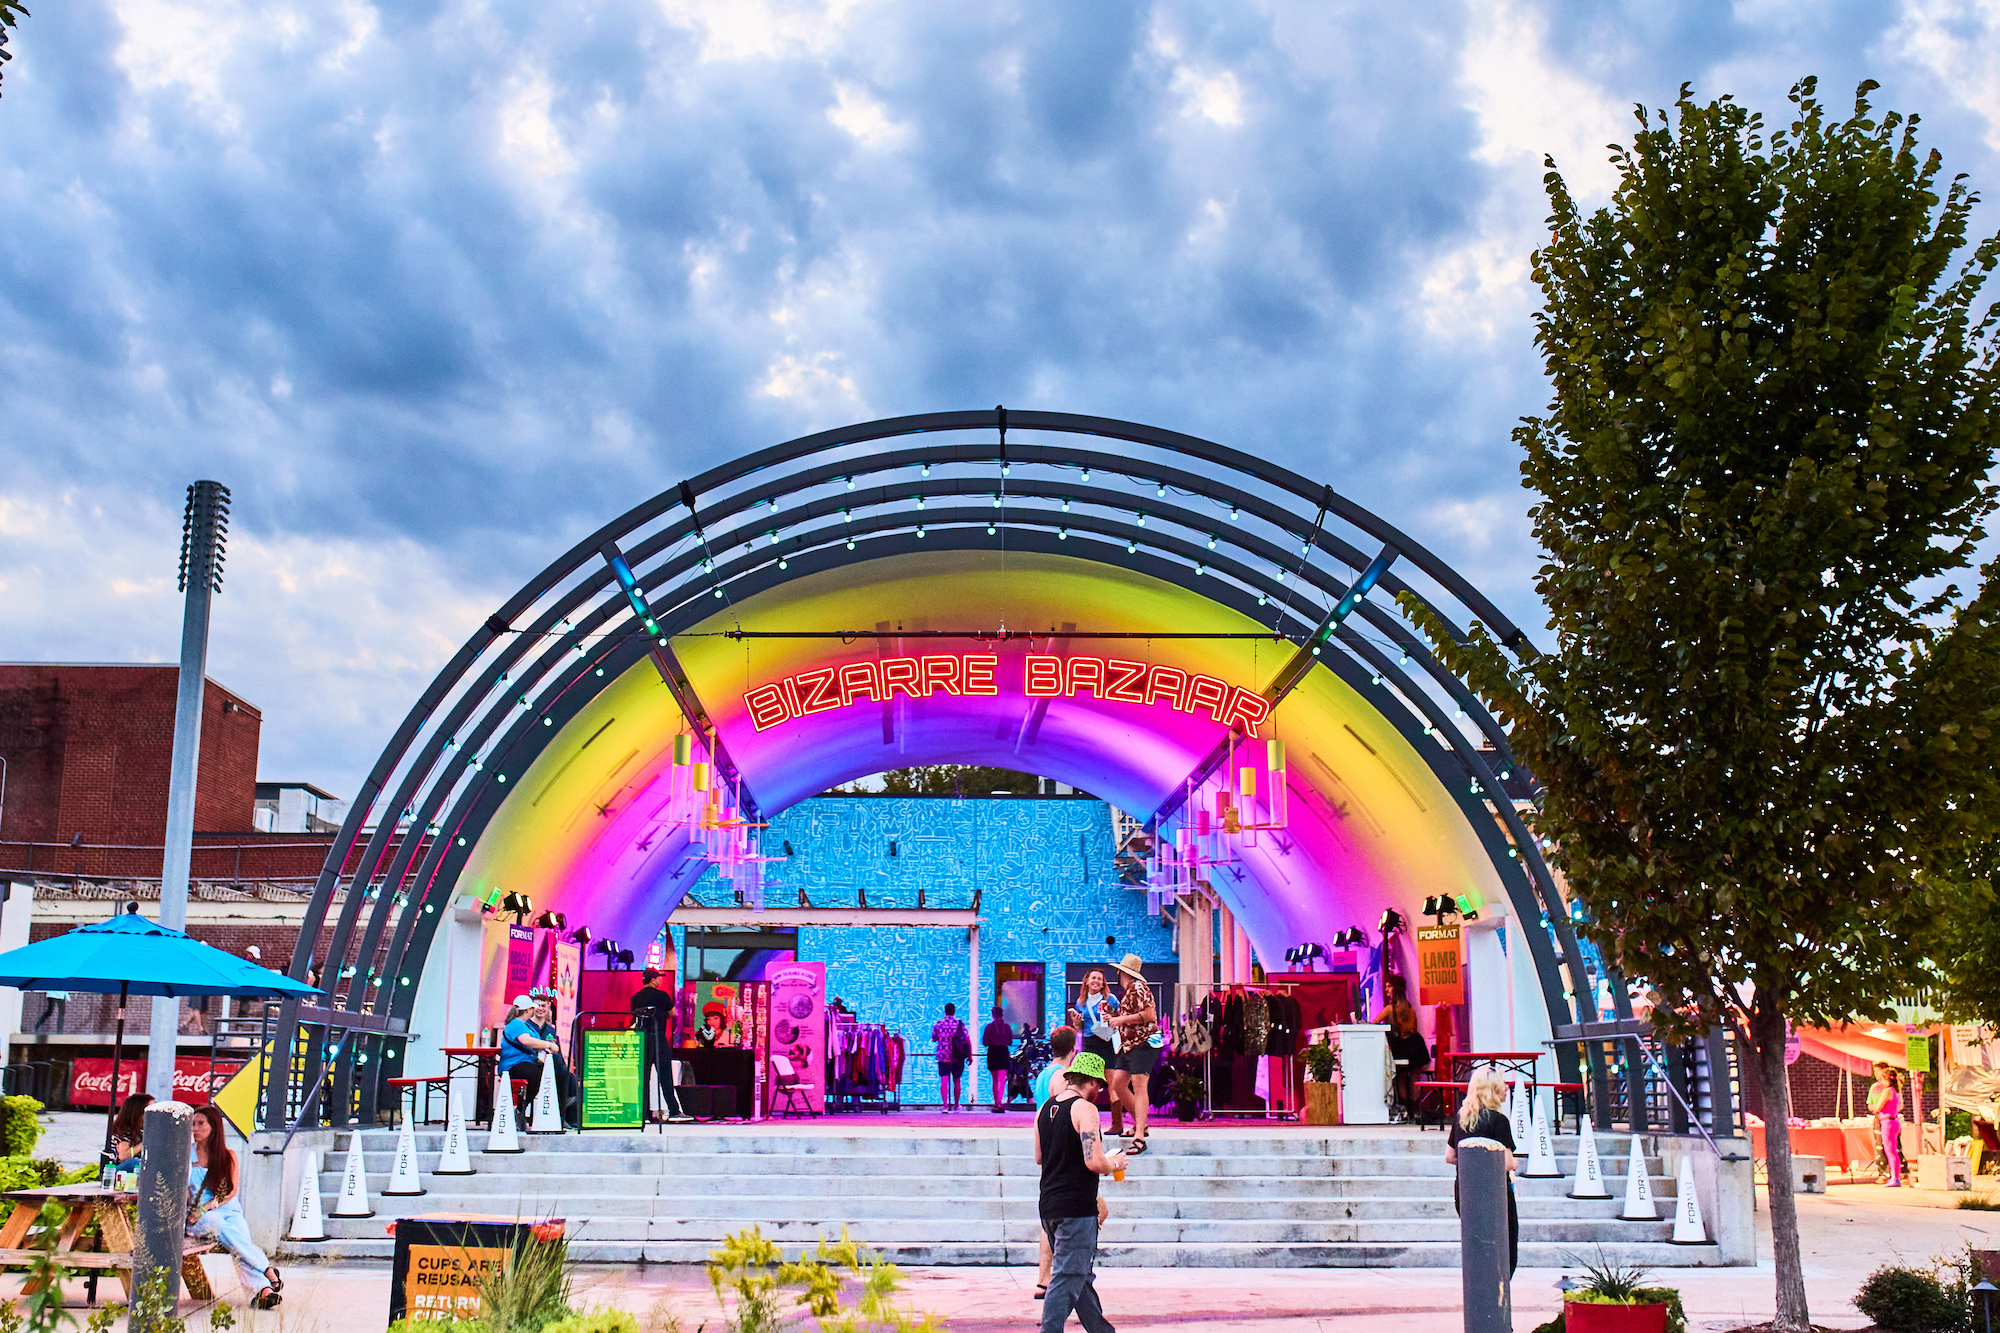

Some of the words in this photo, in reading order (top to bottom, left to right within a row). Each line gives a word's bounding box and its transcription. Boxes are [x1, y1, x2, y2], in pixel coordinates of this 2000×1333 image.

[743, 654, 998, 733] BIZARRE
[1024, 654, 1271, 739] BAZAAR
[510, 928, 533, 942] FORMAT
[1419, 928, 1457, 940] FORMAT
[510, 950, 531, 968] ORACLE
[511, 966, 528, 983] OASIS
[1423, 951, 1457, 969] LAMB
[1424, 969, 1458, 985] STUDIO
[499, 1095, 508, 1134] FORMAT
[542, 1076, 551, 1116] FORMAT
[450, 1114, 459, 1154] FORMAT
[1538, 1117, 1547, 1156] FORMAT
[400, 1133, 410, 1175] FORMAT
[1586, 1140, 1596, 1181] FORMAT
[347, 1153, 358, 1196] FORMAT
[1636, 1160, 1646, 1200] FORMAT
[301, 1176, 312, 1219] FORMAT
[1686, 1182, 1696, 1224] FORMAT
[417, 1272, 484, 1288] REUSA
[418, 1257, 460, 1270] CUPS
[467, 1260, 502, 1272] ARE
[415, 1294, 480, 1310] RETURN
